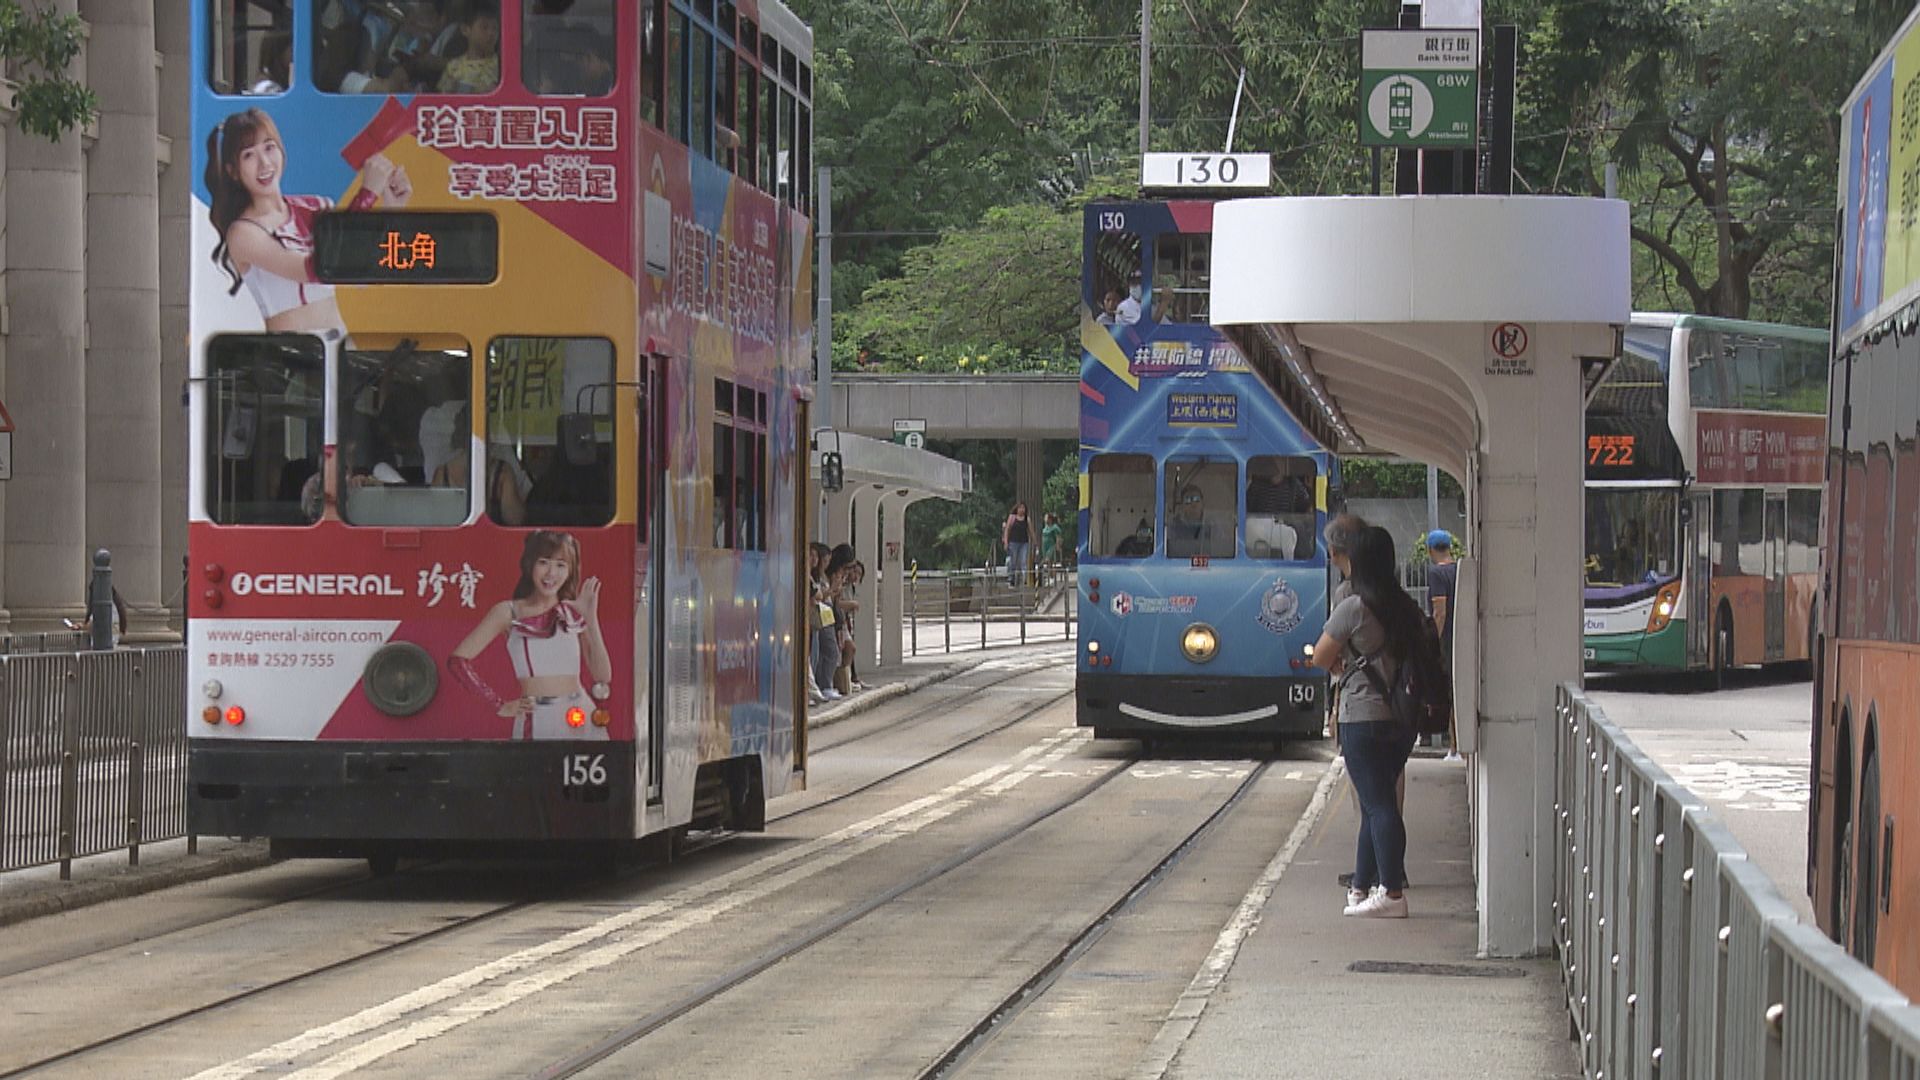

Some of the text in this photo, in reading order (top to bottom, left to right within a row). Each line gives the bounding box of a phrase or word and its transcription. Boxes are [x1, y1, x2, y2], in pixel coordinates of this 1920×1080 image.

[1425, 37, 1470, 51] 銀行街
[1417, 54, 1470, 62] Bank Street
[1437, 74, 1470, 87] 68W
[1177, 157, 1239, 184] 130
[1098, 212, 1125, 231] 130
[379, 232, 436, 269] 北角
[1497, 368, 1511, 376] Not
[1512, 368, 1534, 376] Climb
[1589, 446, 1633, 465] 722
[254, 574, 404, 595] GENERAL
[207, 628, 383, 645] www.general-aircon.com
[207, 653, 335, 668] 查詢熱線 2529 7555
[1288, 684, 1315, 703] 130
[563, 754, 607, 786] 156
